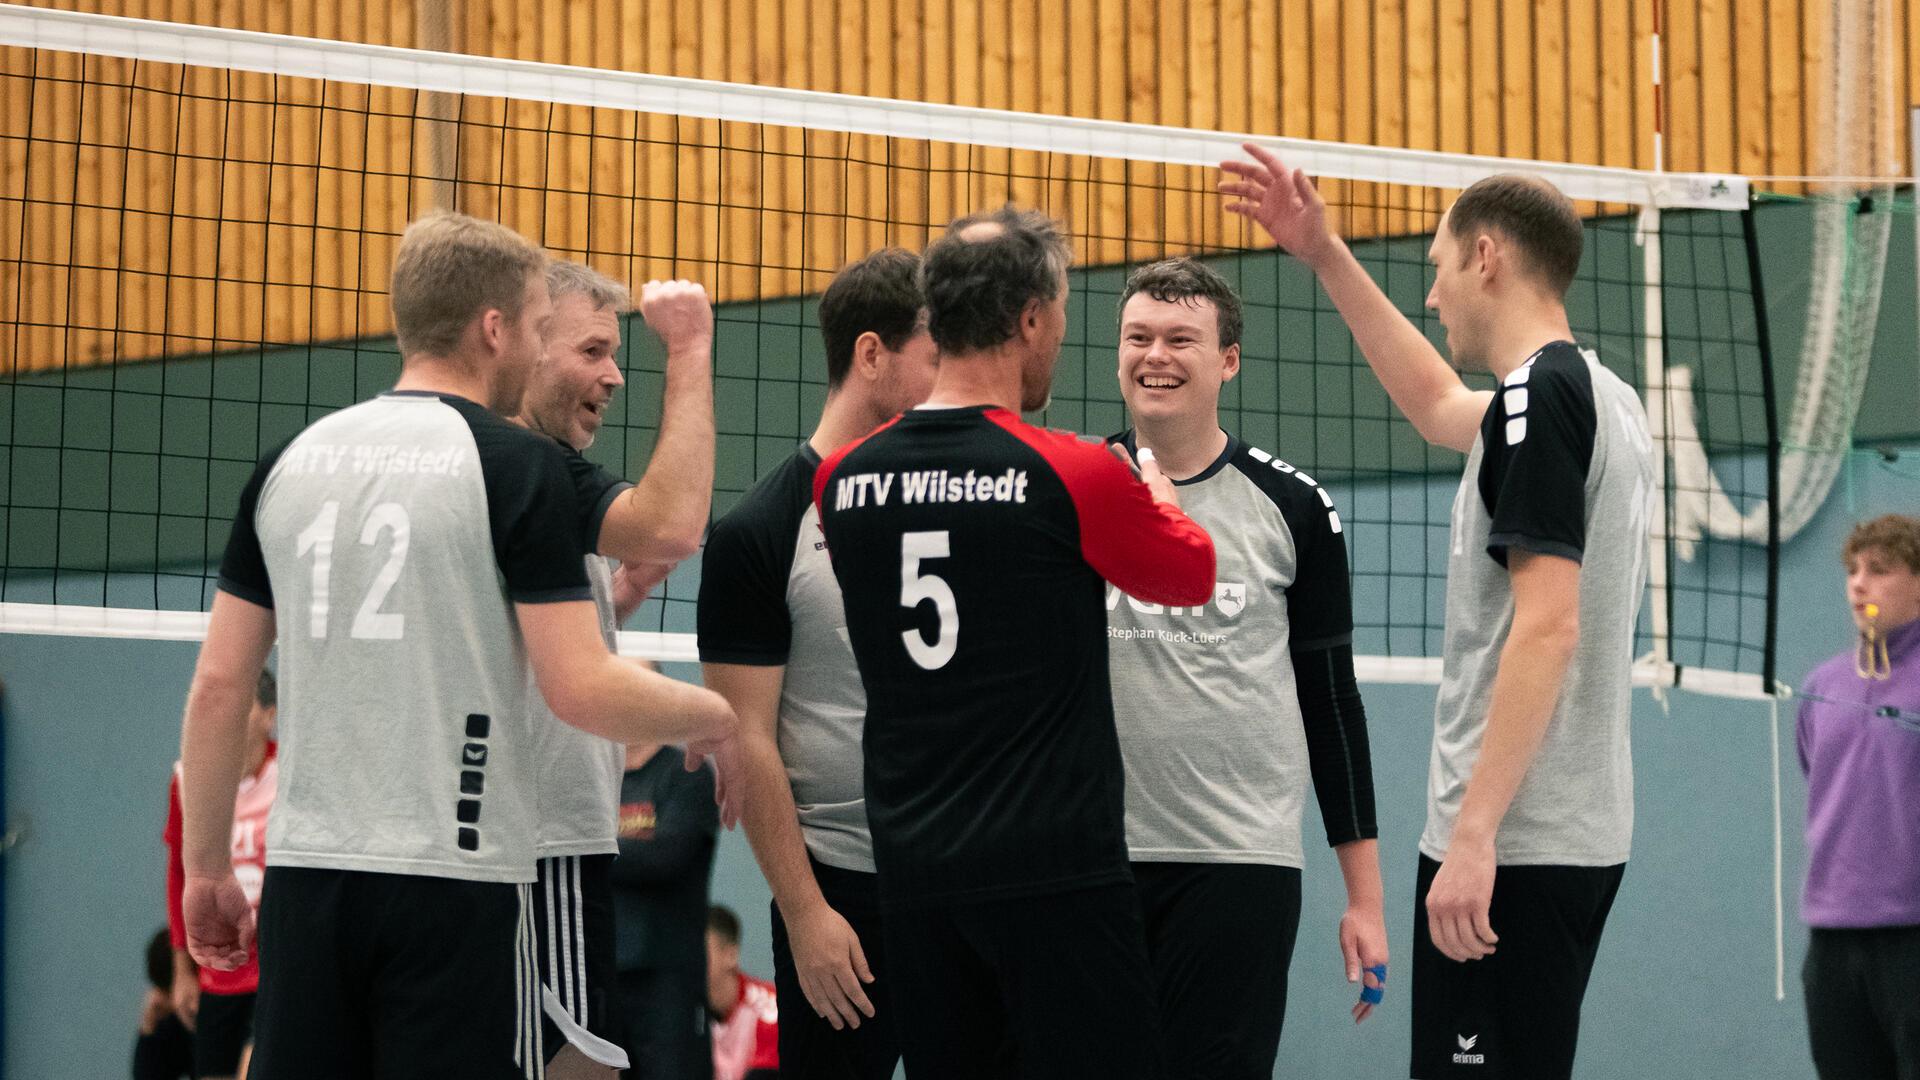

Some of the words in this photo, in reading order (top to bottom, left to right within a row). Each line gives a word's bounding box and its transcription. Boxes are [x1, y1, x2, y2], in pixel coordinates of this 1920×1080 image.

[285, 444, 348, 475] MTV
[351, 444, 466, 477] Wilstedt
[835, 472, 895, 511] MTV
[901, 468, 1029, 504] Wilstedt
[296, 501, 411, 639] 12
[900, 530, 960, 670] 5
[1106, 626, 1155, 641] Stephan
[1158, 629, 1228, 644] Kück-Lüers
[1452, 1052, 1485, 1064] erima
